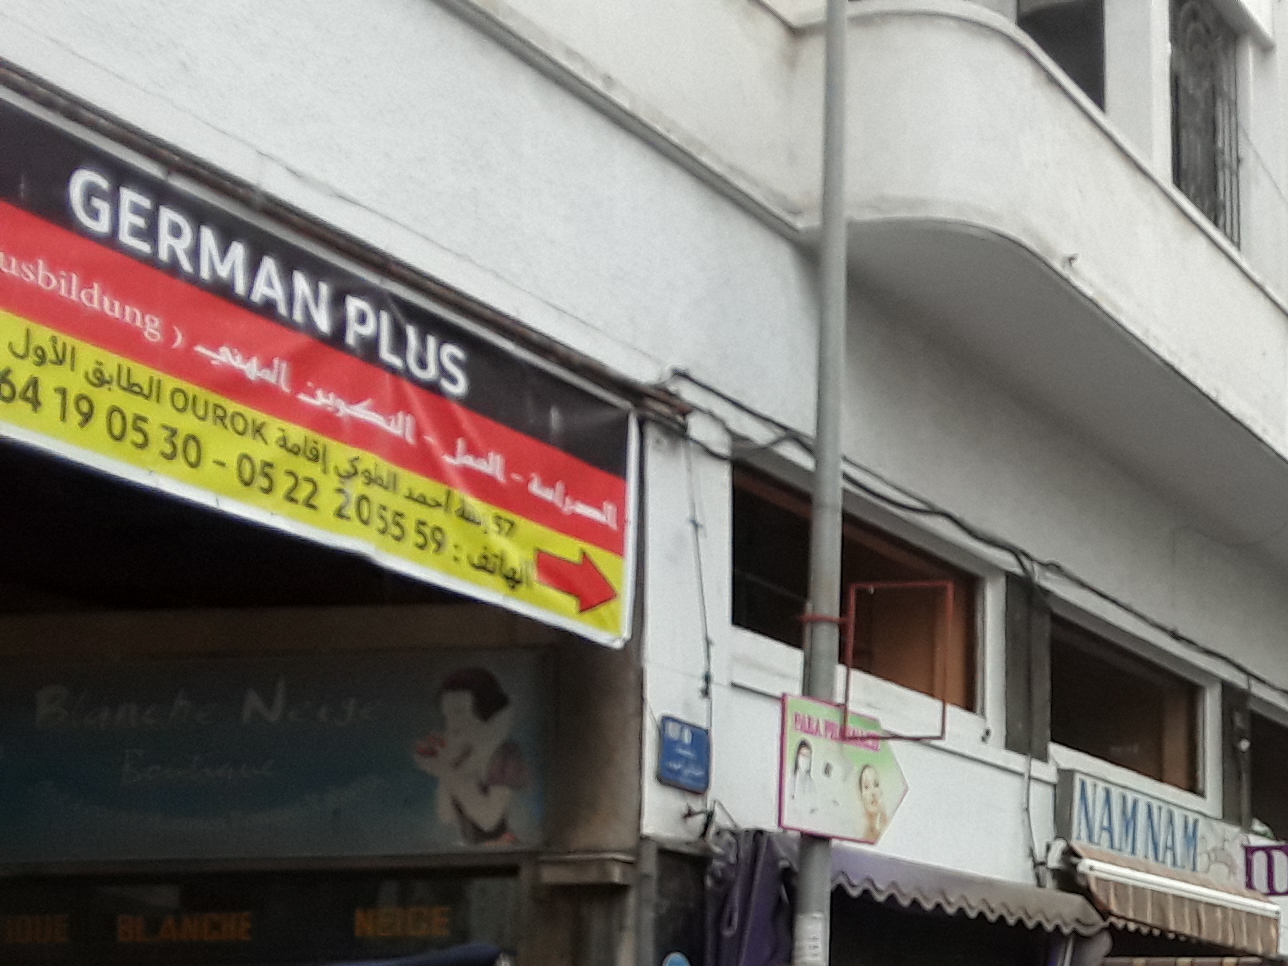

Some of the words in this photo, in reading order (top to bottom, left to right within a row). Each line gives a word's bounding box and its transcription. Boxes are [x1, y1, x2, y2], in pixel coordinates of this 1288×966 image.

[68, 167, 332, 336] GERMAN
[344, 293, 470, 398] PLUS
[7, 327, 76, 373] الأول
[83, 359, 162, 405] الطابق
[53, 385, 95, 430] 19
[105, 404, 150, 450] 05
[169, 386, 269, 446] OUROK
[160, 422, 203, 469] 30
[236, 451, 274, 495] 05
[283, 469, 319, 512] 22
[35, 682, 214, 730] Blanche
[241, 675, 376, 726] Neige
[1074, 778, 1140, 856] NAM
[1145, 801, 1199, 873] NAM
[116, 911, 251, 943] BLANCHE
[353, 904, 451, 938] NEIGE
